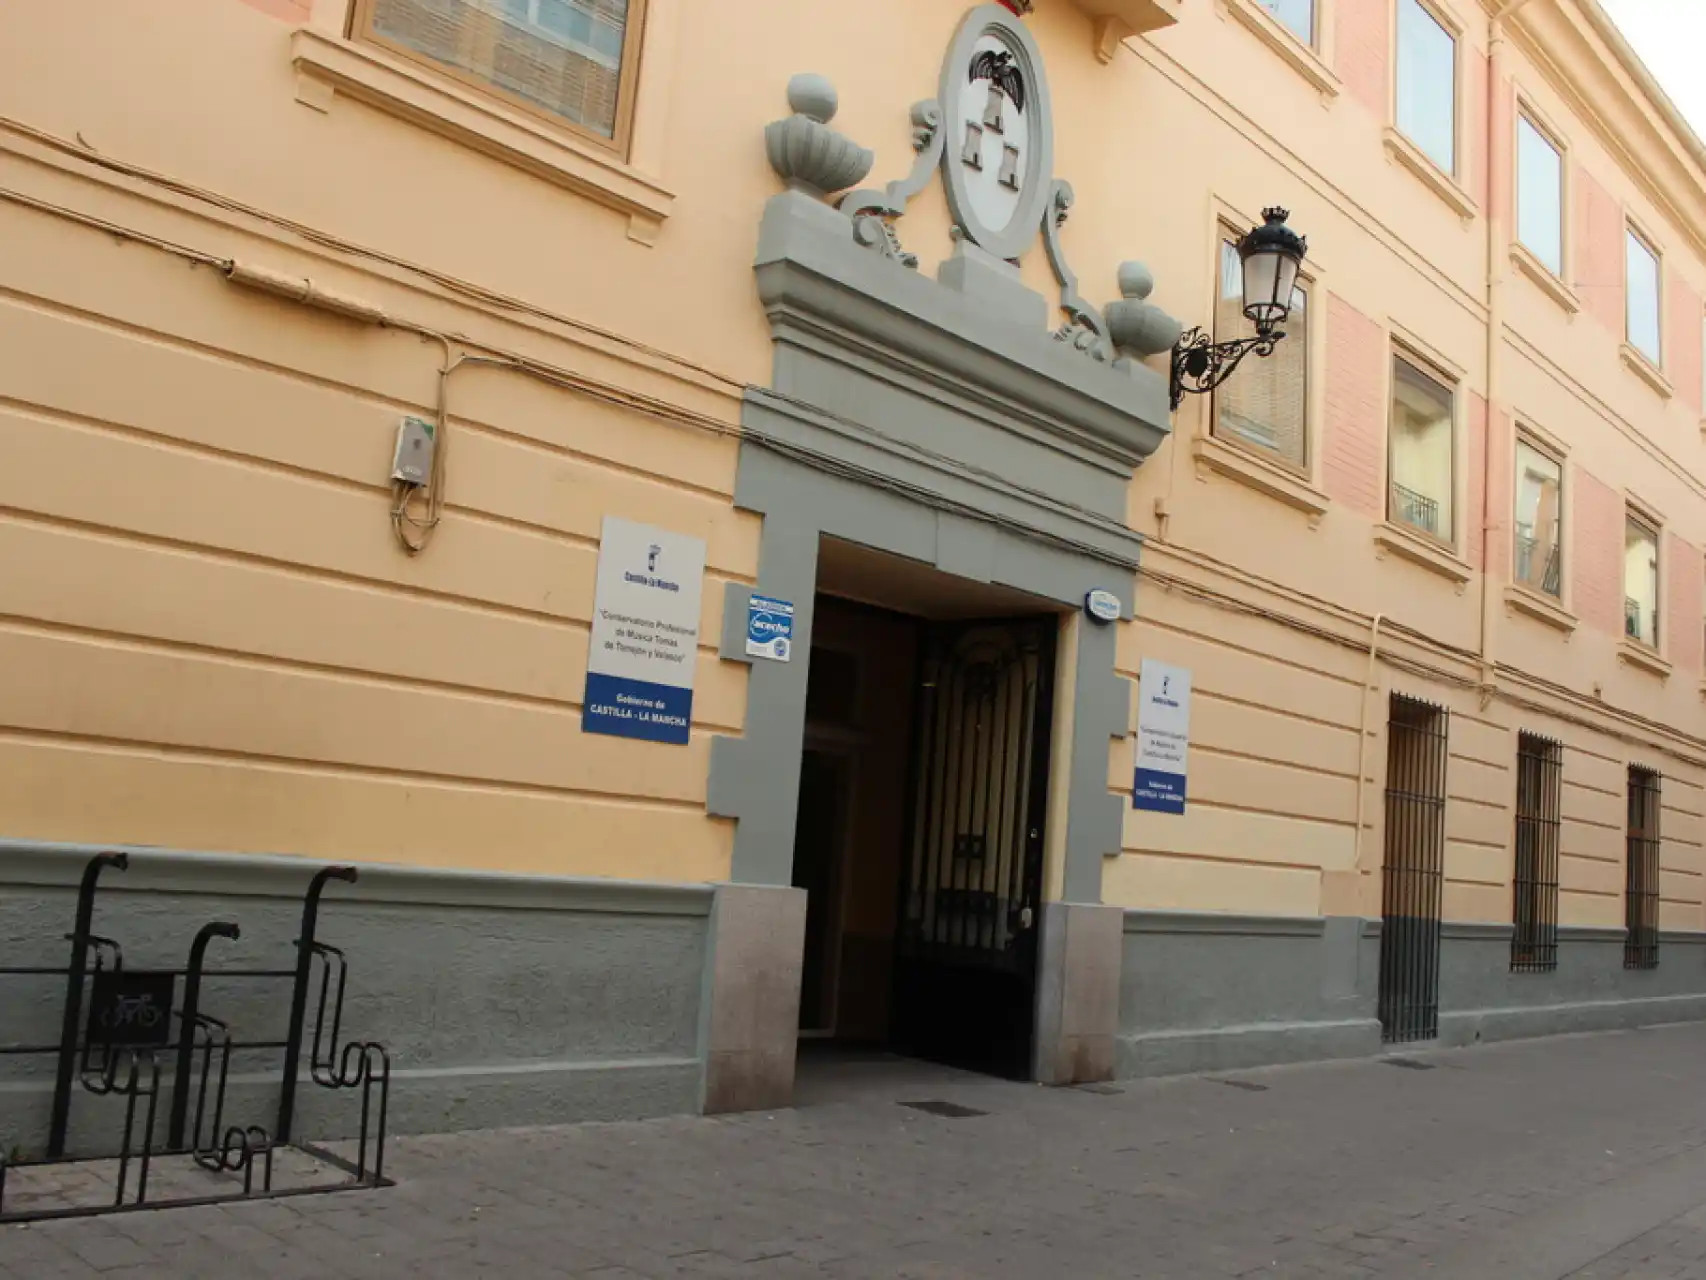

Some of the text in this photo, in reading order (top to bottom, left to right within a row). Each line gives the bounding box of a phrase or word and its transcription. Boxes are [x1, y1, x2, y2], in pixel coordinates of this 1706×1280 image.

[590, 704, 633, 718] CASTILLA
[639, 711, 650, 721] LA
[652, 713, 687, 727] MANCHA
